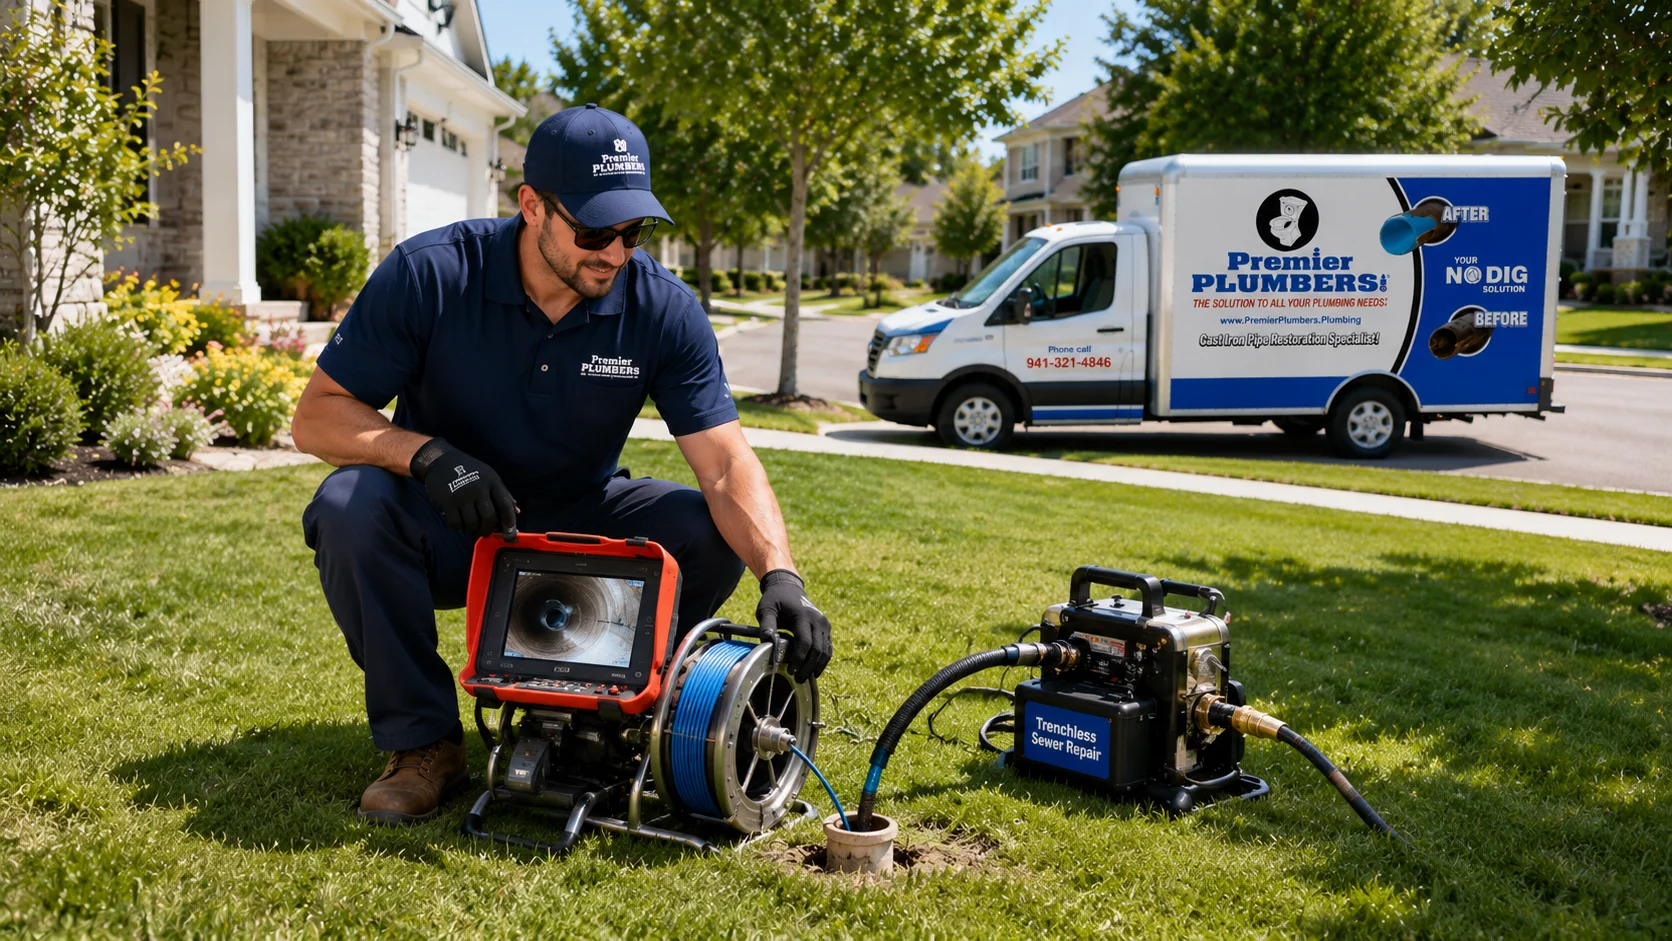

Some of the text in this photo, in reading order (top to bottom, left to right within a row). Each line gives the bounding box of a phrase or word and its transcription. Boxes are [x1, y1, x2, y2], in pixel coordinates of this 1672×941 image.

[1442, 206, 1490, 222] AFTER
[1227, 247, 1353, 271] Premier
[1454, 256, 1478, 265] YOUR
[1486, 265, 1528, 284] DIG
[1482, 285, 1526, 293] SOLUTION
[1193, 299, 1210, 308] THE
[1212, 298, 1256, 308] SOLUTION
[1257, 298, 1269, 308] TO
[1270, 298, 1286, 308] ALL
[1287, 298, 1311, 308] YOUR
[1312, 298, 1356, 307] PLUMBING
[1220, 315, 1362, 325] www.PremierPlumbers.Plumbing
[1474, 311, 1529, 327] BEFORE
[1224, 333, 1246, 347] Iron
[1246, 332, 1269, 348] Pipe
[1269, 332, 1327, 347] Restoration
[1327, 331, 1381, 348] Specialist!
[1048, 345, 1092, 353] Phone call
[591, 354, 633, 366] Premier
[1026, 356, 1112, 368] 941-321-4846
[581, 363, 640, 375] PLUMBERS
[1036, 716, 1097, 743] Trenchless
[1031, 731, 1102, 761] Sewer Repair
